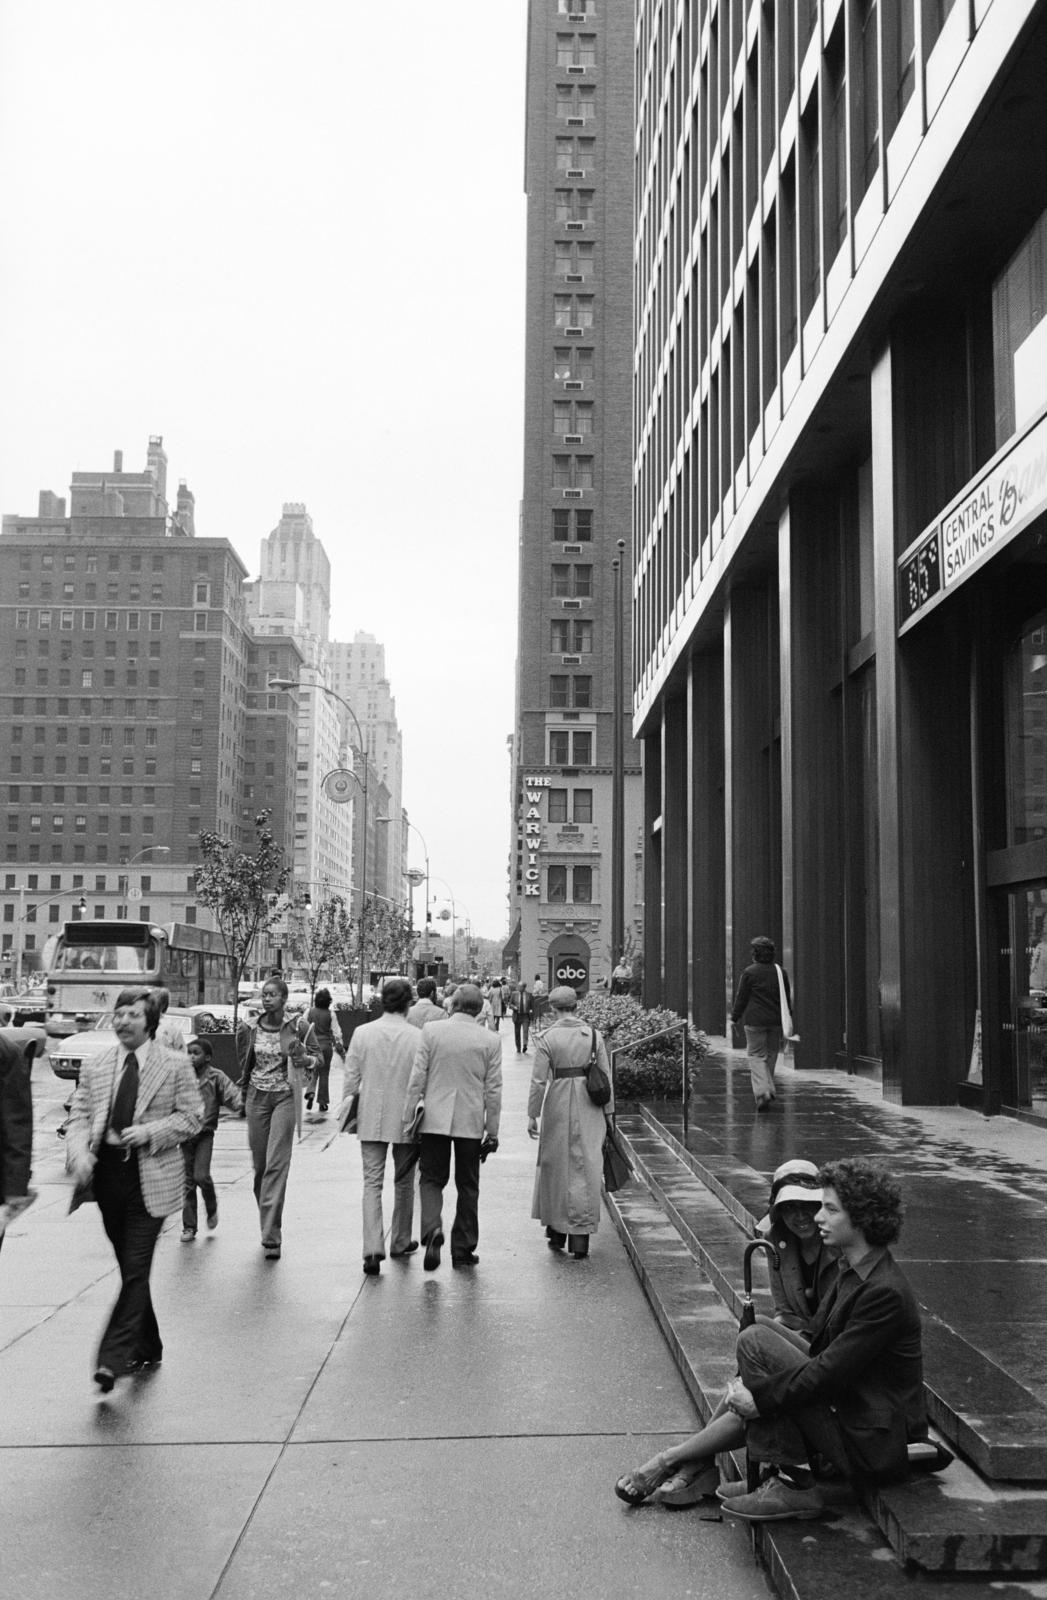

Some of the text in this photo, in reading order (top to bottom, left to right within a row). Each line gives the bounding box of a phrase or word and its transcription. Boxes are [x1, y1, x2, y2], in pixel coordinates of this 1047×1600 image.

[945, 485, 994, 548] CENTRAL
[946, 514, 995, 578] SAVINGS
[525, 776, 552, 787] THE
[525, 791, 541, 896] WARWICK
[556, 964, 587, 979] abc
